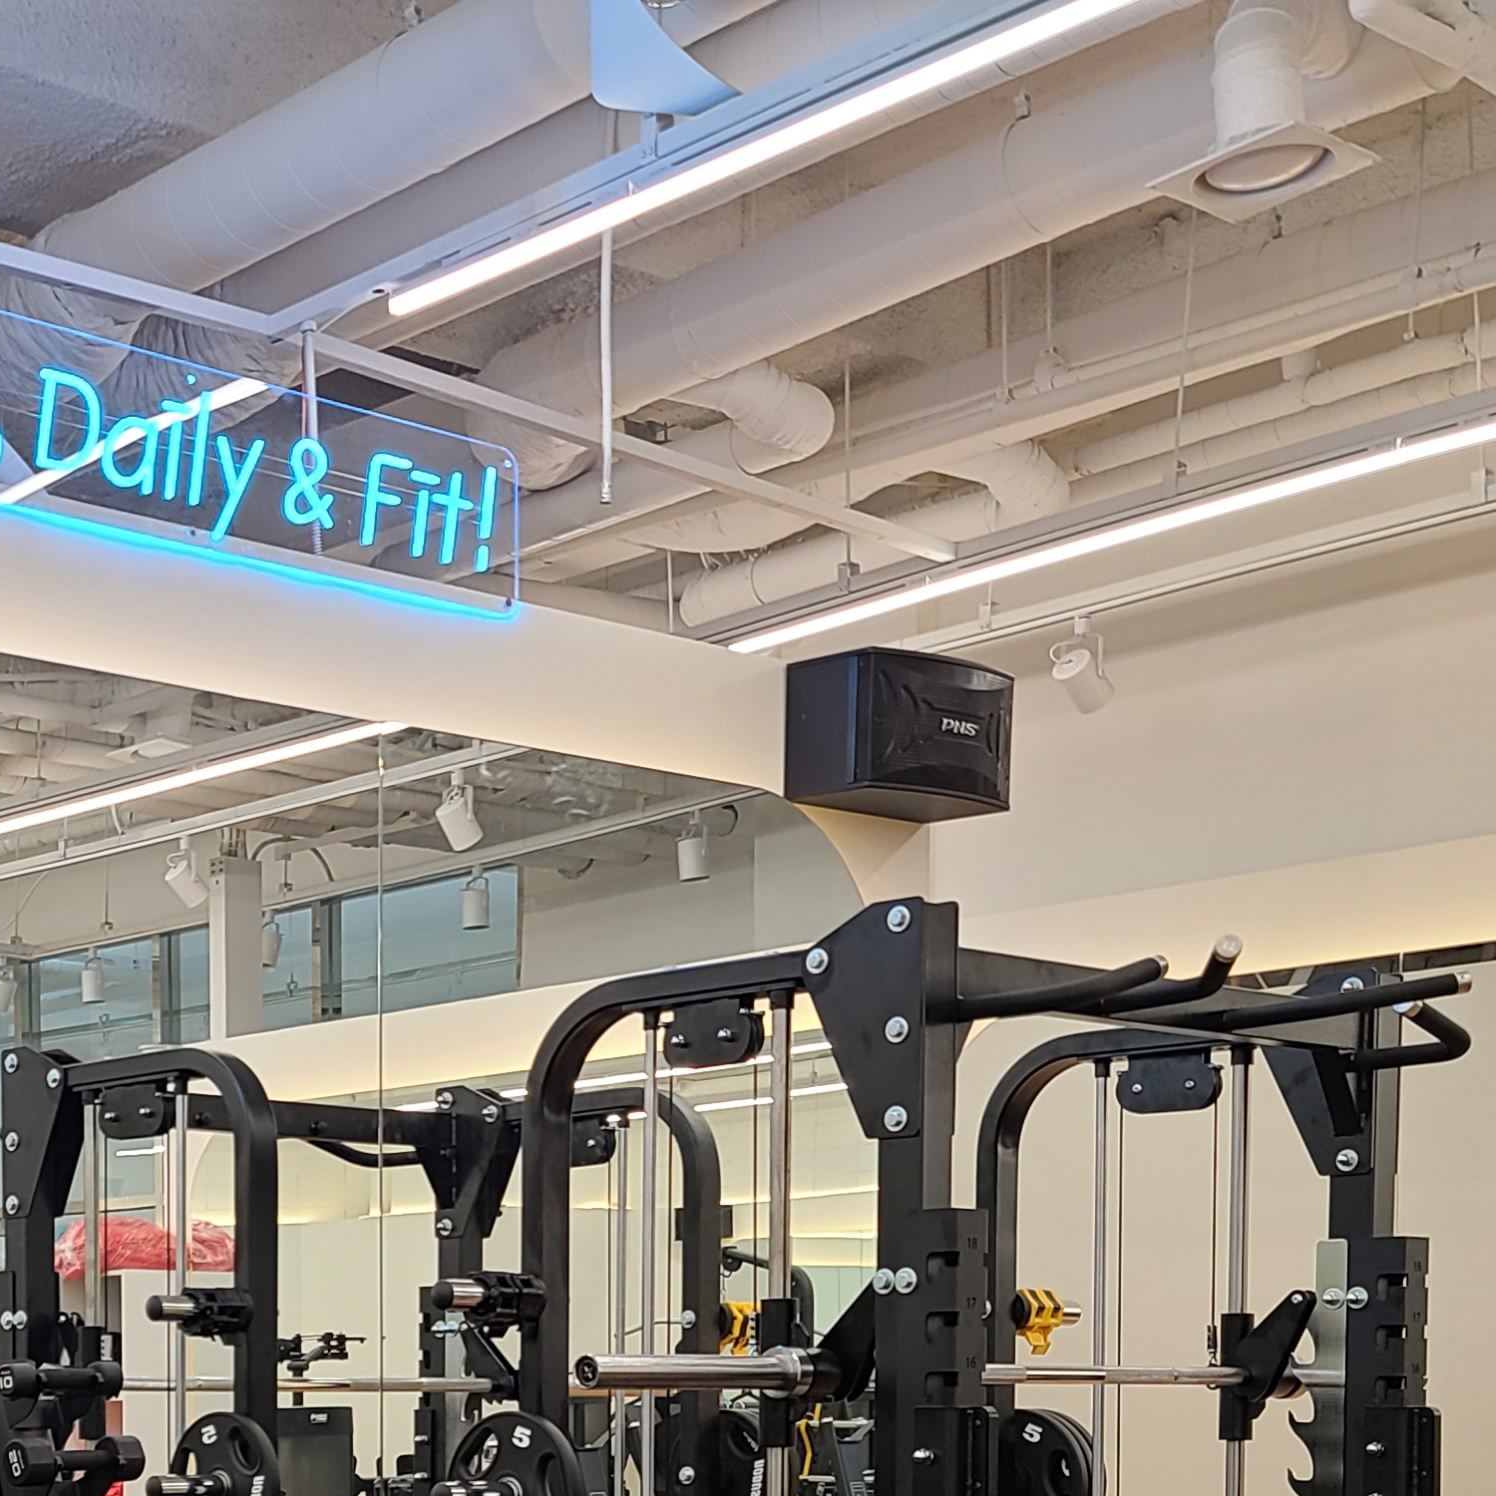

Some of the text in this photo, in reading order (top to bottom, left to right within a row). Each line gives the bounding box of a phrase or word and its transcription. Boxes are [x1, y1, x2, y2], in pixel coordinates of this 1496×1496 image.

[33, 366, 266, 543] Daily
[282, 437, 335, 530] &
[360, 452, 498, 574] Fit!
[941, 716, 980, 737] PNS
[967, 1237, 978, 1250] 18
[966, 1297, 977, 1309] 17
[965, 1357, 977, 1370] 16
[511, 1425, 532, 1448] 5
[1022, 1422, 1043, 1443] 5
